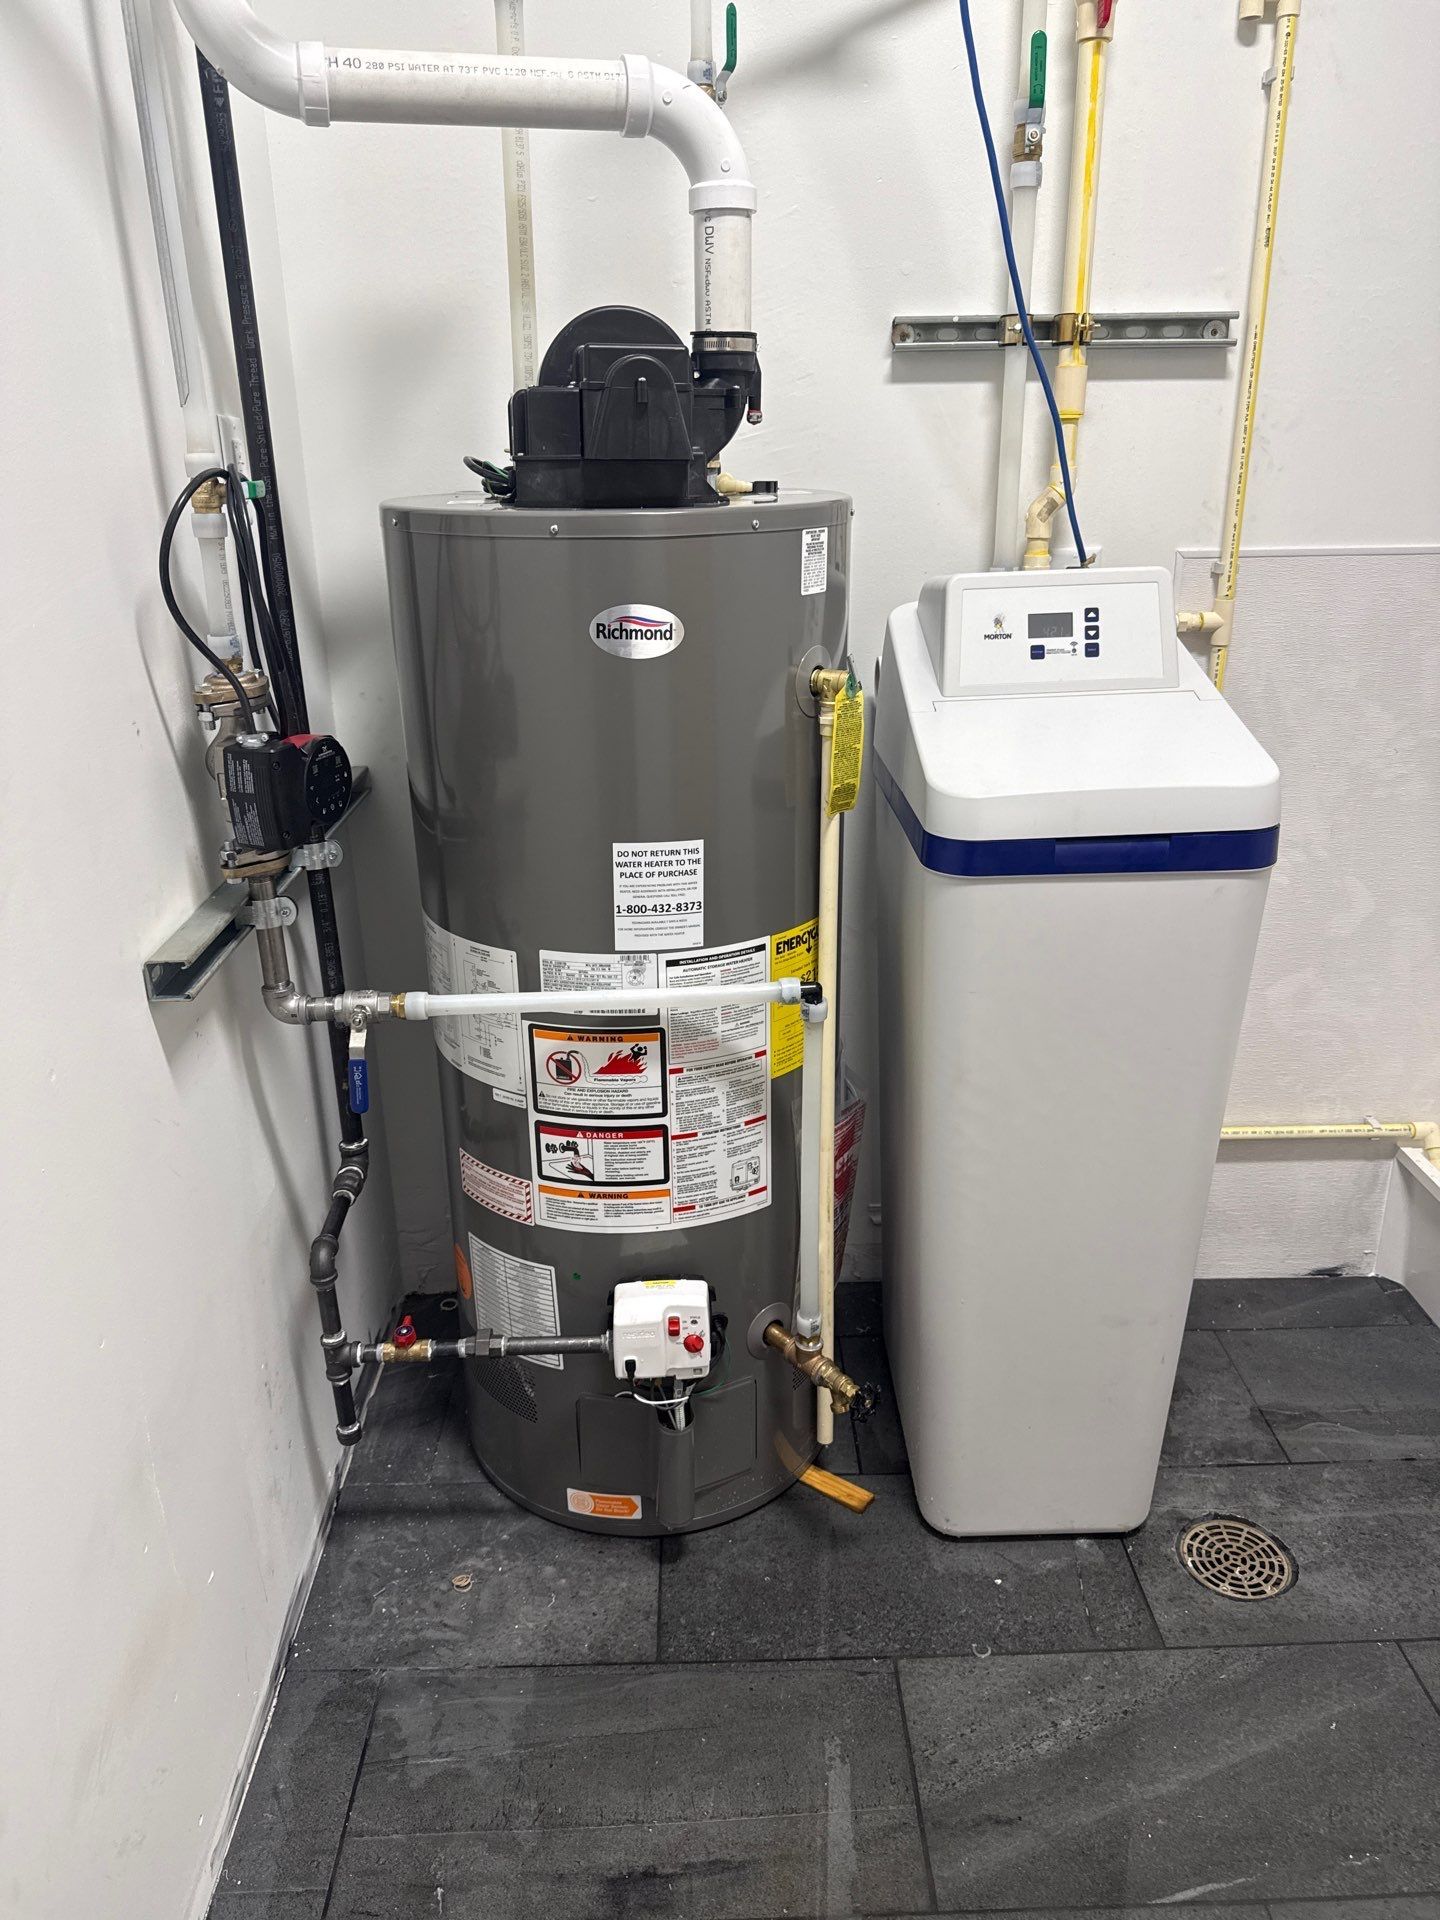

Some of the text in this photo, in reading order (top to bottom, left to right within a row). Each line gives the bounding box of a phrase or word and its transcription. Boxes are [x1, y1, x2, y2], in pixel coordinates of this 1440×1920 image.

[325, 57, 339, 68] H
[343, 57, 361, 68] 40
[388, 62, 405, 71] PSI
[408, 64, 439, 73] WATER
[443, 65, 455, 73] AT
[483, 67, 500, 75] PVC
[704, 226, 714, 254] DWV
[240, 282, 253, 327] Pressure
[249, 356, 258, 386] Thread
[259, 449, 268, 469] Pure
[596, 622, 673, 640] Richmond
[658, 869, 697, 877] PURCHASE
[616, 901, 702, 914] 1-800-432-8373
